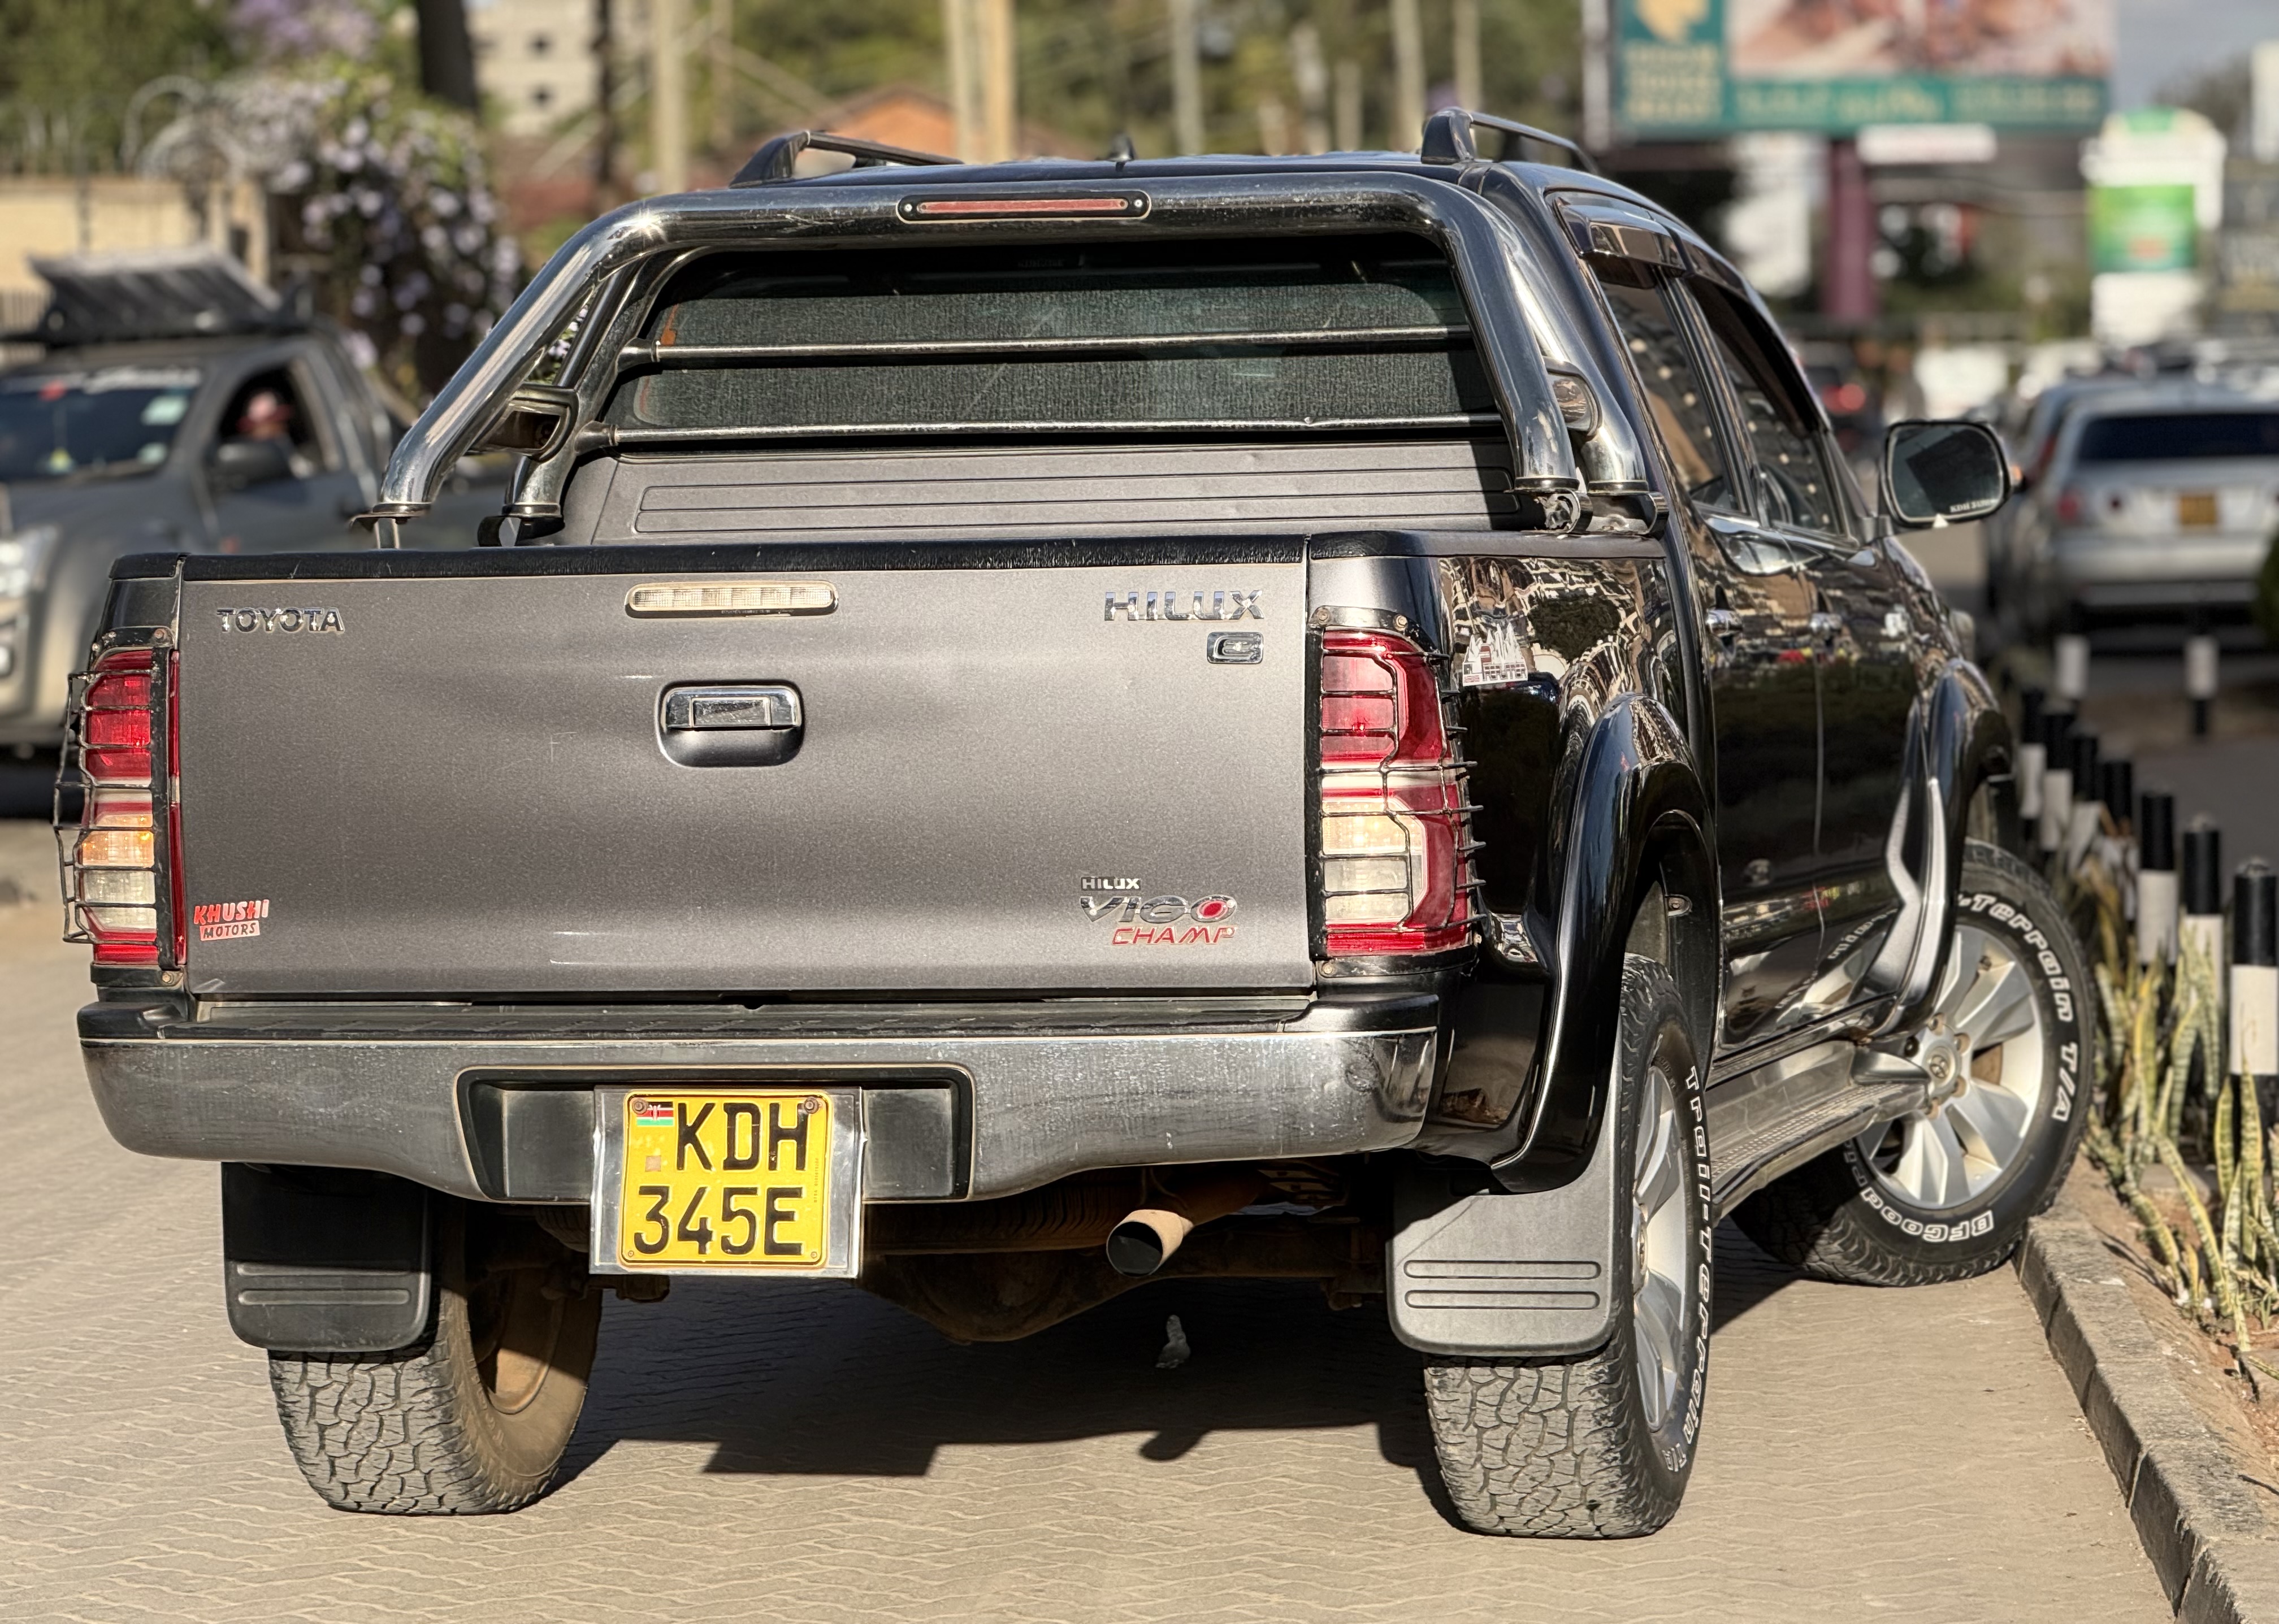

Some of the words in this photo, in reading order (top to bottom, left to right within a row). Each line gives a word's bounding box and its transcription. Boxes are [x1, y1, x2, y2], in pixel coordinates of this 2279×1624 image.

[1104, 590, 1265, 620] HILUX
[216, 607, 345, 633] TOYOTA
[1209, 633, 1263, 662] G
[1081, 877, 1141, 890] HILUX
[194, 899, 270, 924] KHUSHI
[1079, 895, 1238, 923] VIGO
[203, 922, 257, 940] MOTORS
[1112, 925, 1238, 945] CHAMP
[677, 1102, 810, 1171] KDH
[634, 1186, 804, 1256] 345E
